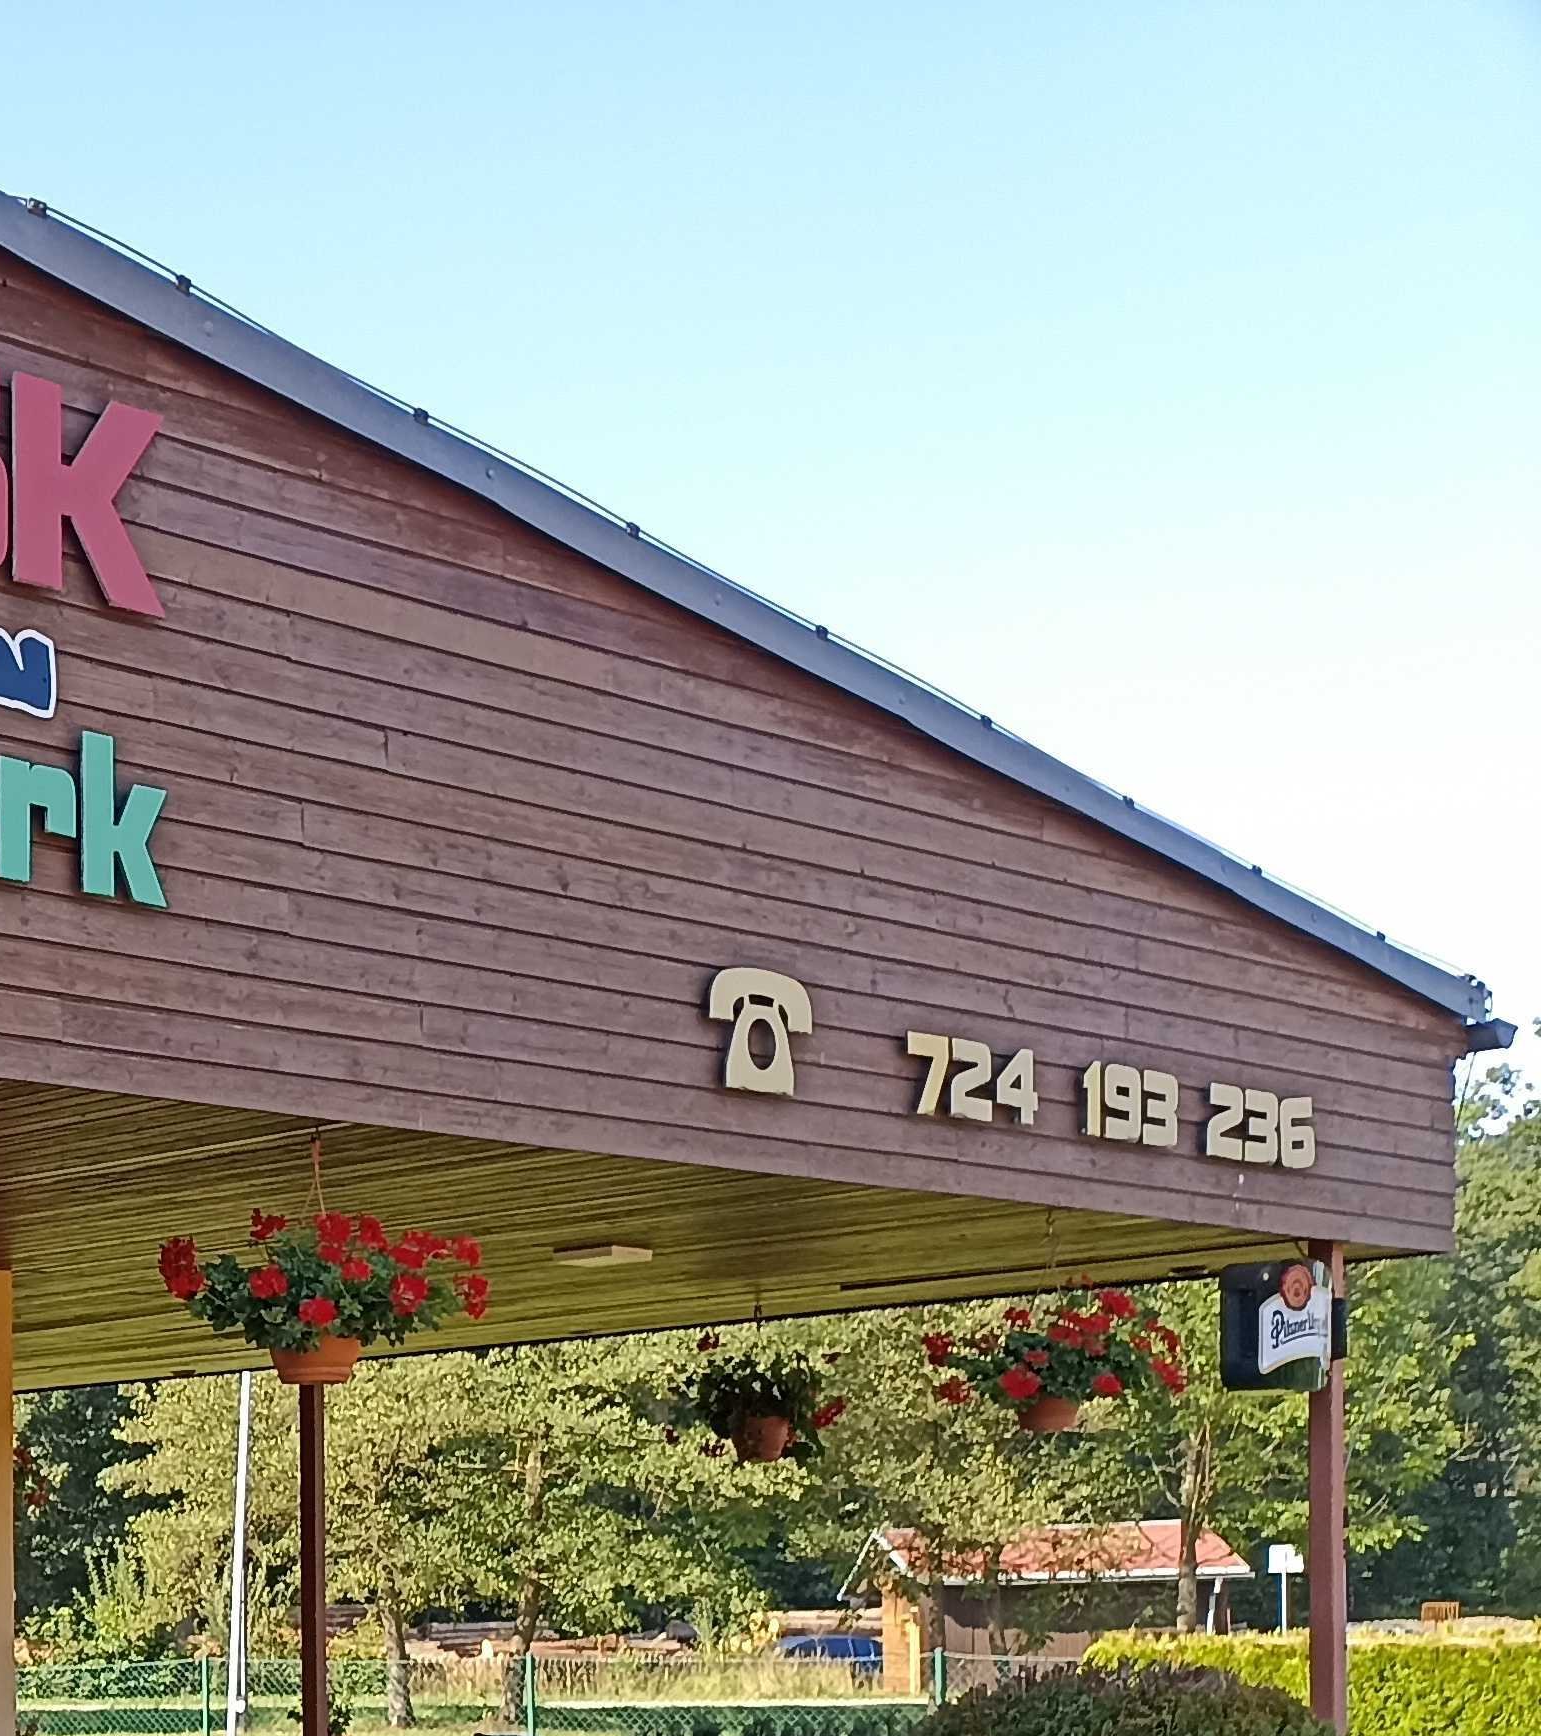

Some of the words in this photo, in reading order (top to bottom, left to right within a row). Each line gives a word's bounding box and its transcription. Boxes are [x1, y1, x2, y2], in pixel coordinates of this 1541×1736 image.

[906, 1030, 1039, 1126] 724
[1083, 1059, 1179, 1148] 193
[1205, 1081, 1316, 1169] 236
